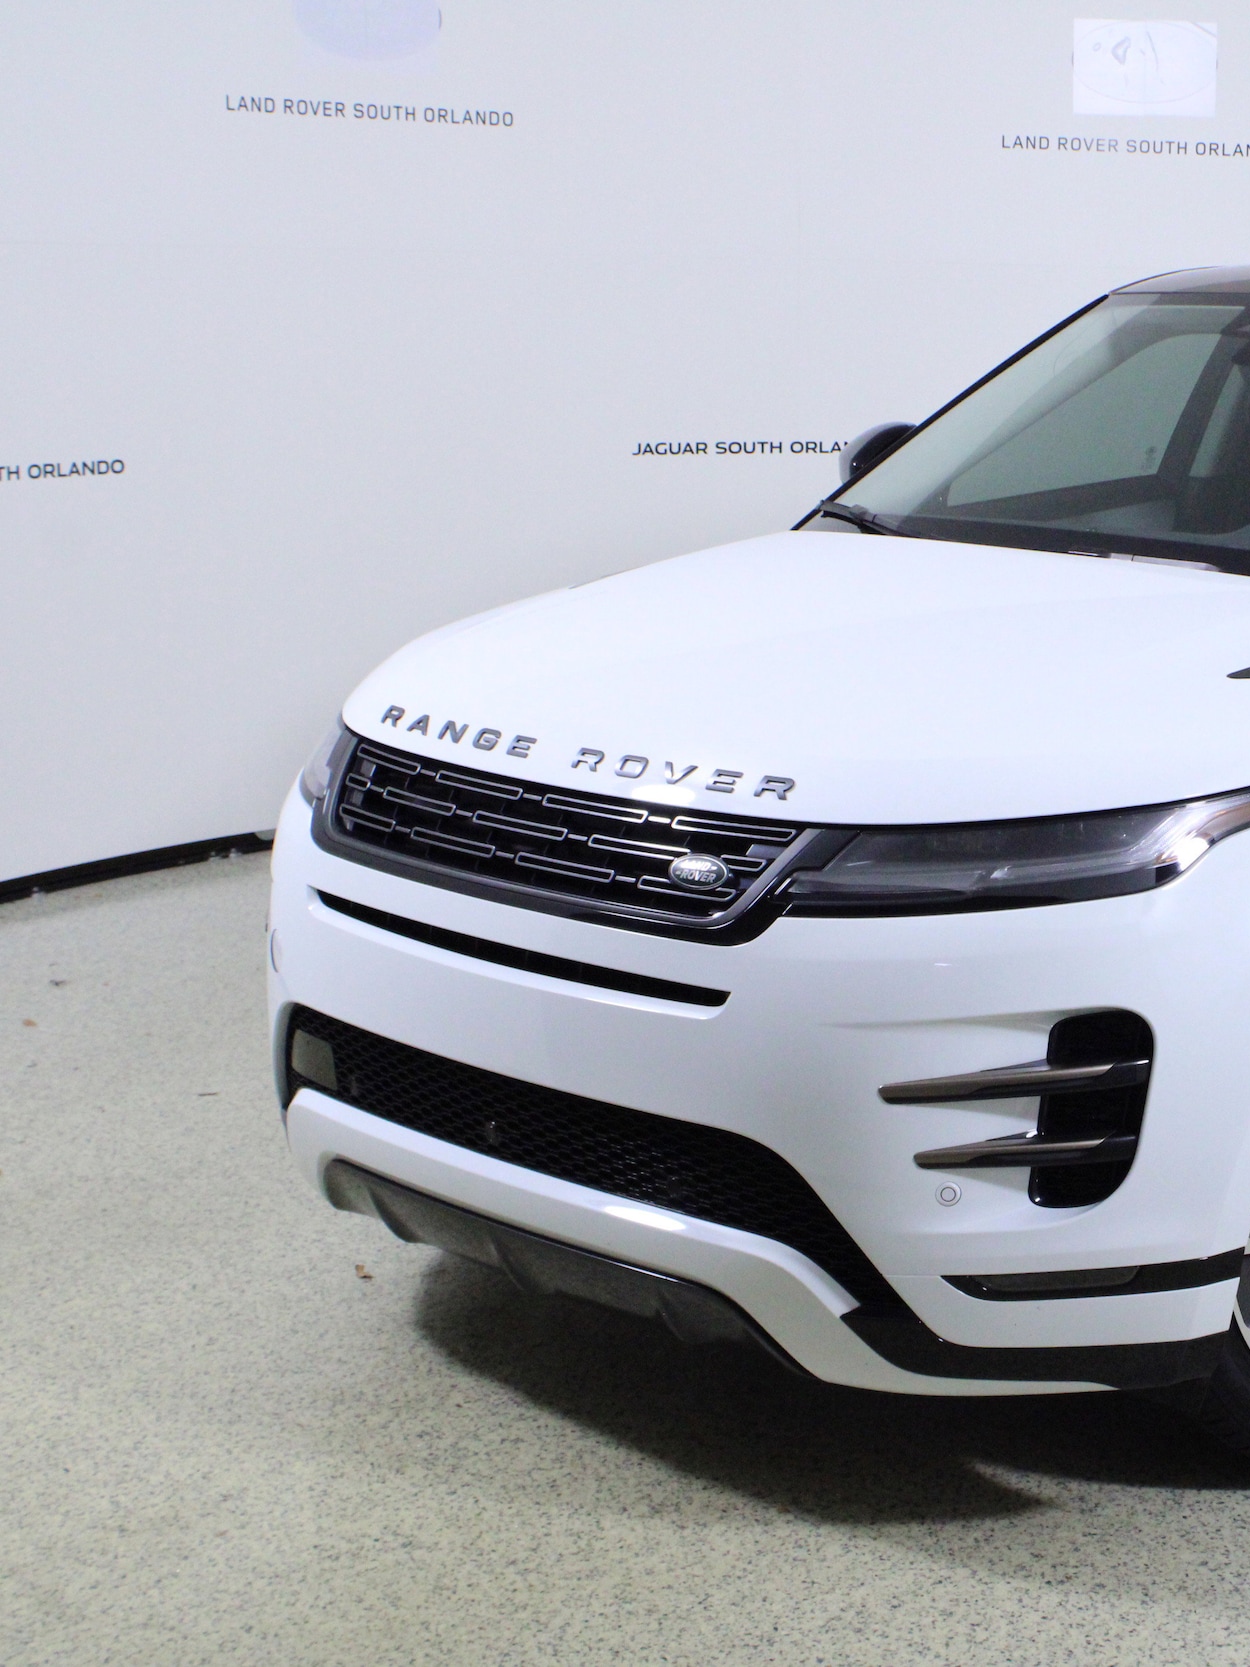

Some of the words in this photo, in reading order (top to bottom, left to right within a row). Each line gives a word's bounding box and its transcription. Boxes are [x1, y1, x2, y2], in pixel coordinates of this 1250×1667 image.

[225, 94, 276, 113] LAND
[283, 98, 346, 118] ROVER
[352, 102, 417, 122] SOUTH
[423, 106, 514, 128] ORLANDO
[1001, 134, 1050, 150] LAND
[1057, 136, 1119, 153] ROVER
[1126, 139, 1188, 156] SOUTH
[631, 441, 709, 456] JAGUAR
[715, 440, 783, 455] SOUTH
[789, 440, 848, 454] ORLA
[27, 458, 125, 479] ORLANDO
[380, 704, 538, 759] RANGE
[570, 746, 797, 802] ROVER
